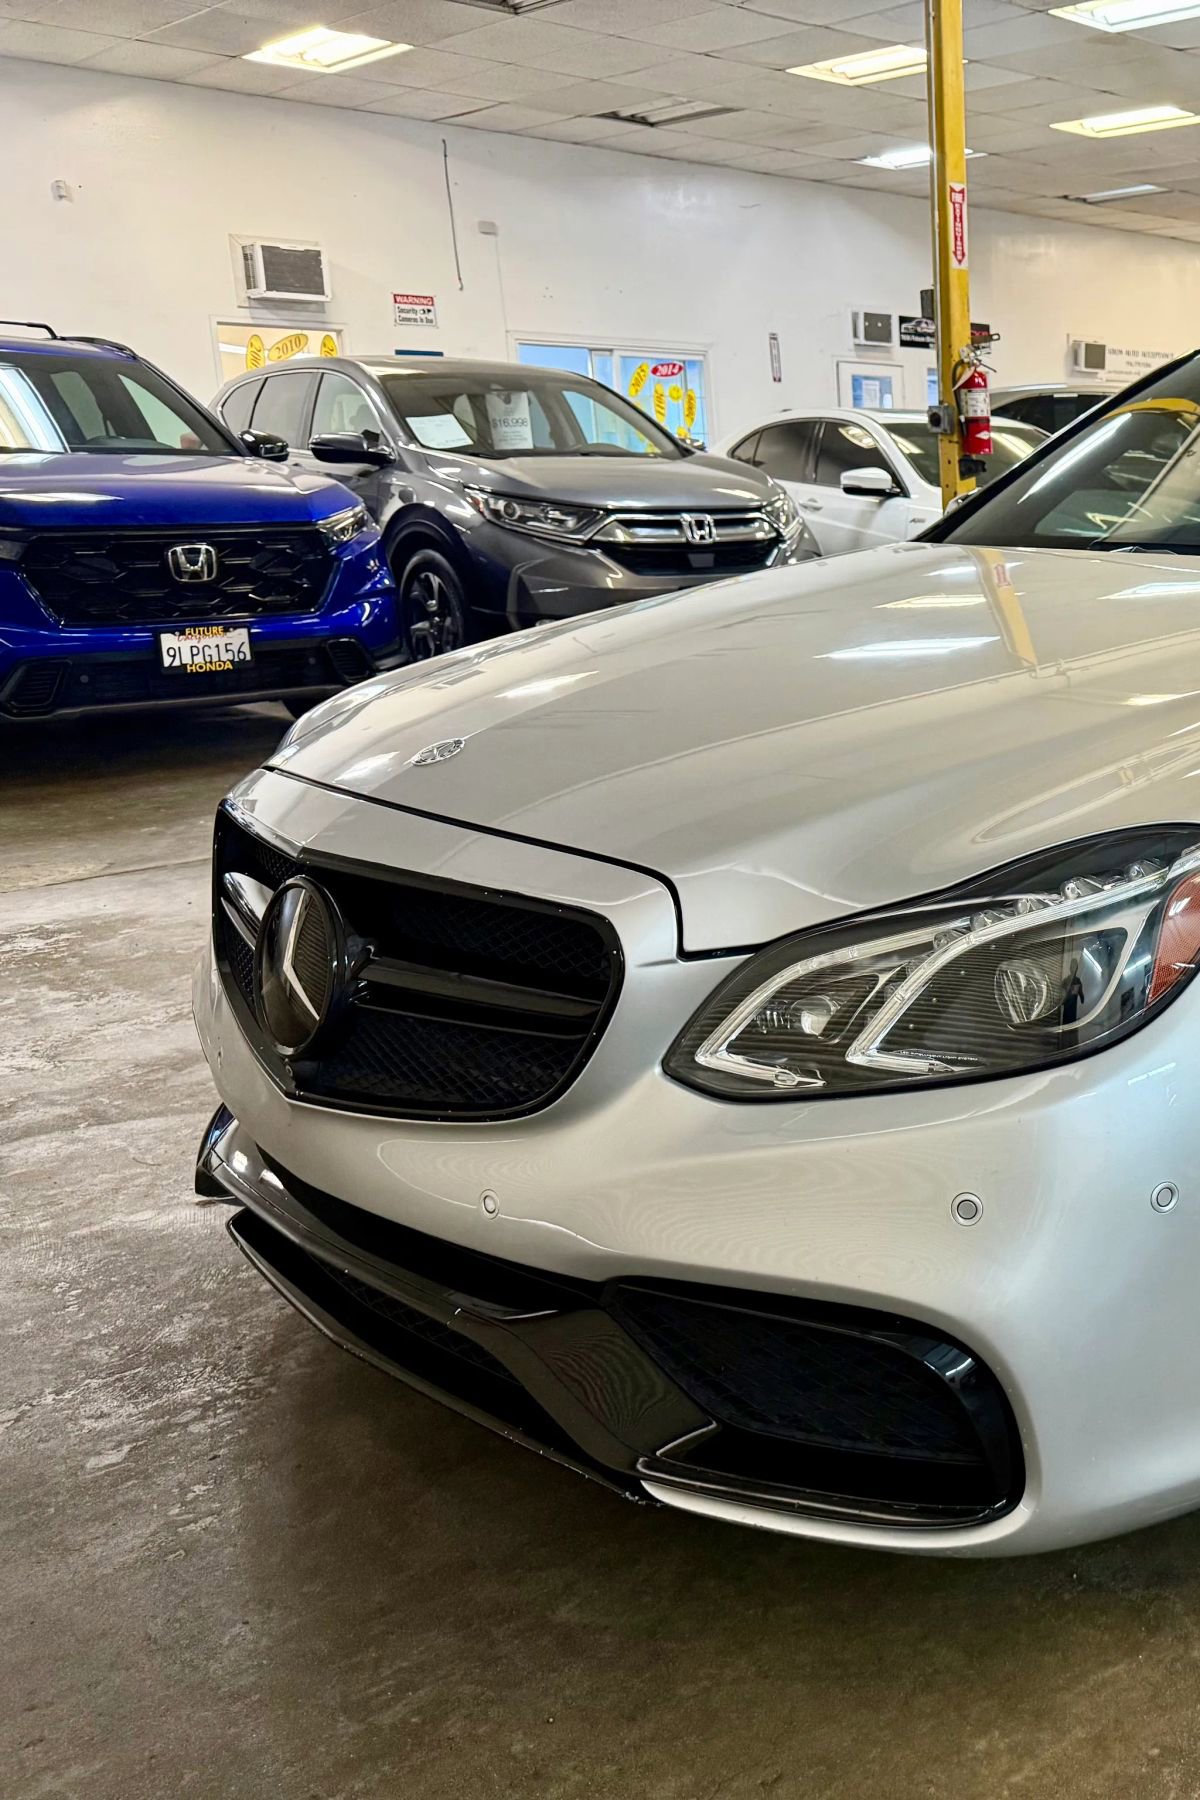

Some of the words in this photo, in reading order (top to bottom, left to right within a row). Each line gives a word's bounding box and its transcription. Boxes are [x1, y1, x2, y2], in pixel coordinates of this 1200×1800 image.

[395, 295, 433, 306] WARNING
[397, 306, 418, 316] Security
[398, 315, 418, 324] Cameras
[275, 335, 302, 359] 2010
[656, 363, 680, 376] 2014
[185, 626, 225, 637] FUTURE
[186, 660, 233, 673] HONDA
